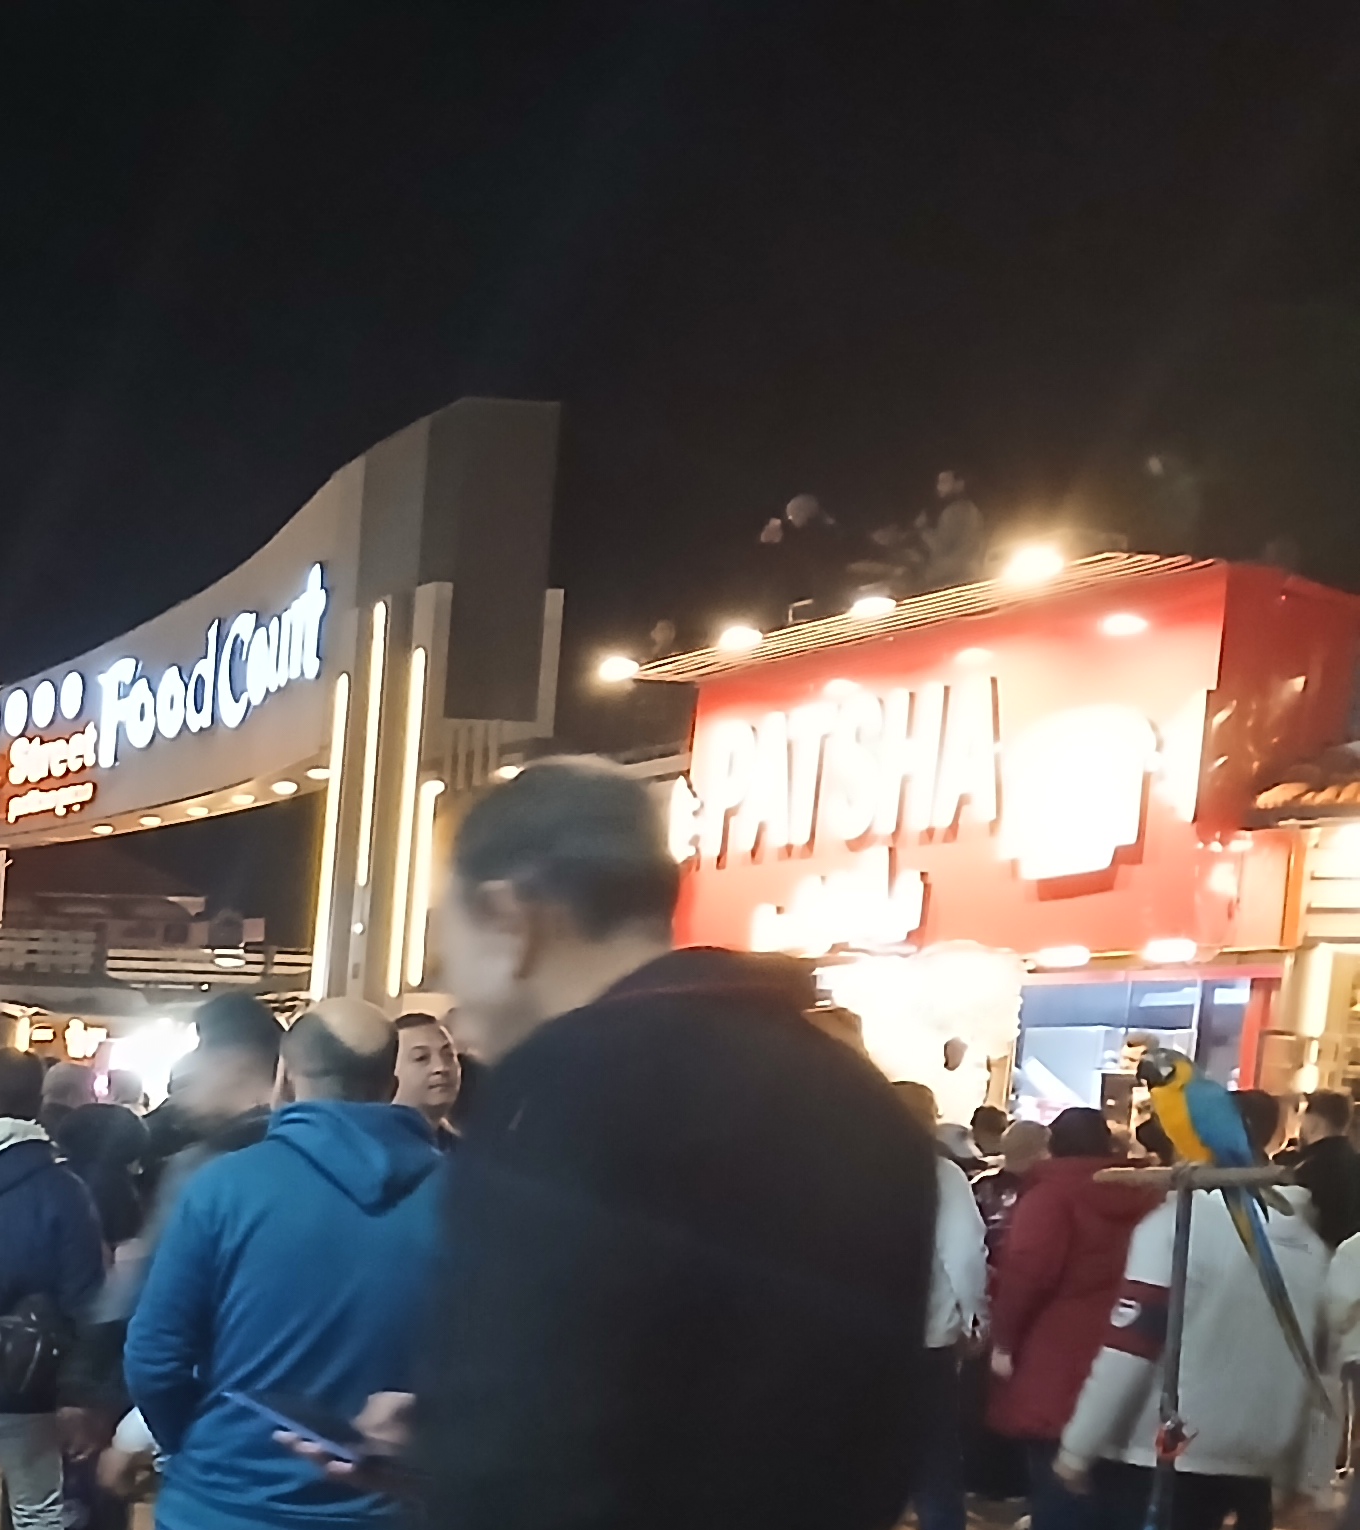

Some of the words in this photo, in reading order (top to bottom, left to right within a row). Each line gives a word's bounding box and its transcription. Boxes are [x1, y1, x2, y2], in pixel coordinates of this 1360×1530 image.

[8, 721, 98, 785] Street
[97, 618, 220, 768] Food
[698, 676, 998, 856] PATSHA
